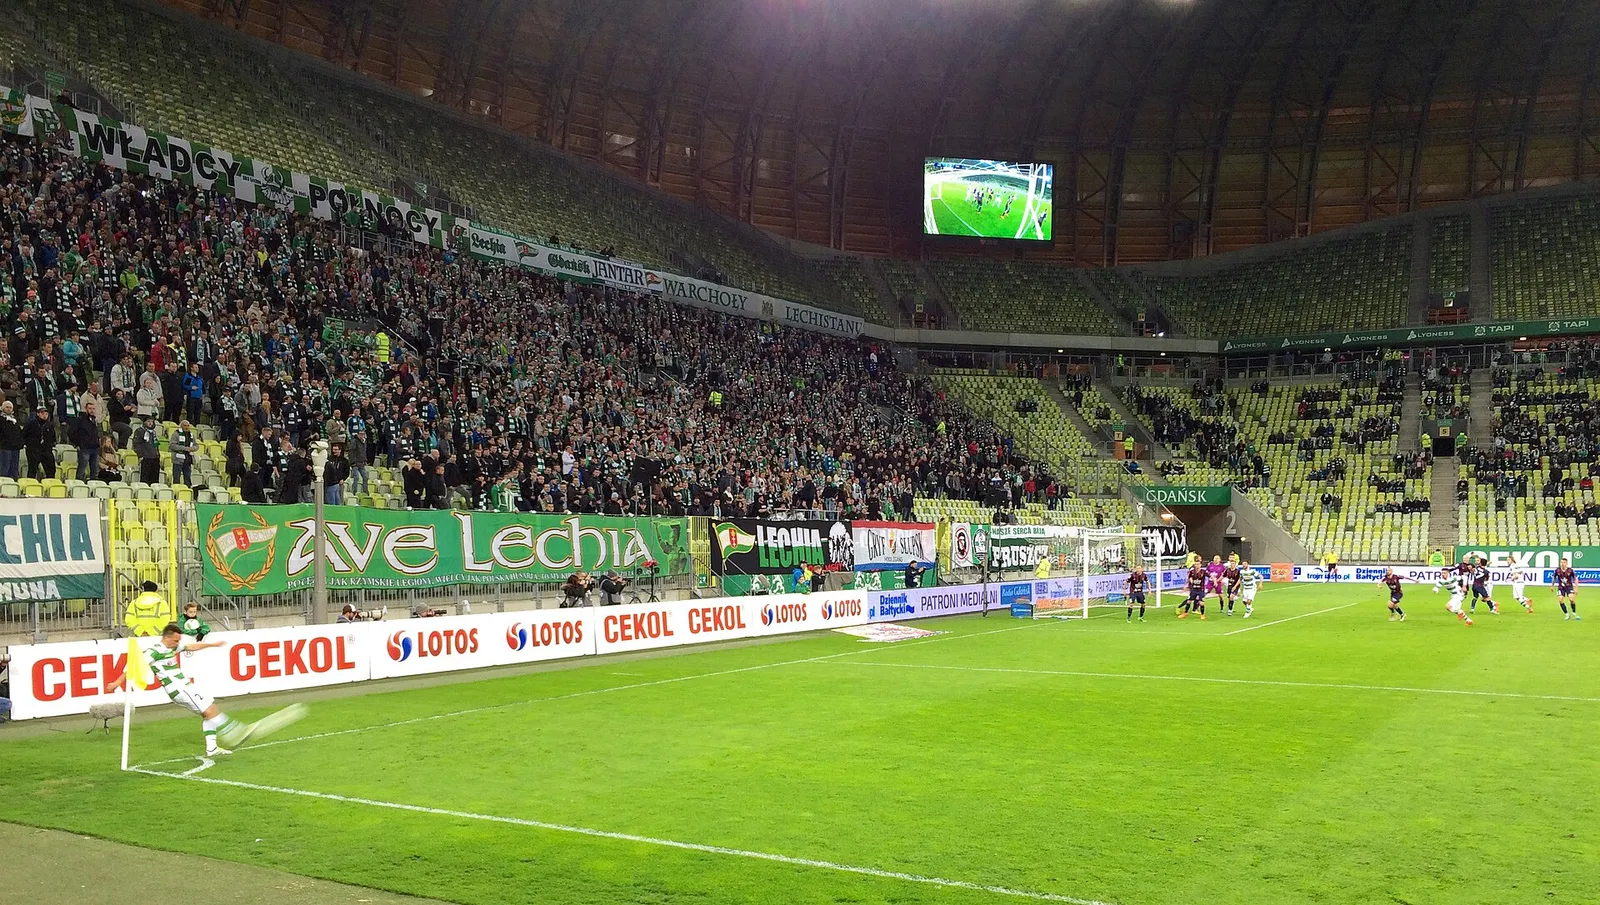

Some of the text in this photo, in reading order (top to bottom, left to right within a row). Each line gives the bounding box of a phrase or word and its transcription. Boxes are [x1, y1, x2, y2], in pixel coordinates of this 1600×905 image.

[82, 121, 241, 187] WŁADCY
[592, 260, 644, 285] JANTAR
[663, 279, 748, 310] WARCHOŁY
[1417, 330, 1454, 338] LYONESS
[1489, 325, 1514, 333] TAPI
[1563, 320, 1589, 328] TAPI
[1145, 488, 1207, 503] GDAŃSK
[1012, 527, 1032, 535] SERCA
[1226, 510, 1237, 535] 2
[756, 525, 825, 568] LECHIA
[868, 529, 885, 560] GRYF
[329, 576, 348, 586] JAK
[834, 599, 861, 618] LOTOS
[880, 593, 907, 605] Dziennik
[880, 603, 907, 617] Bałtycki
[921, 593, 958, 611] PATRONI
[688, 605, 746, 634] CEKOL
[776, 603, 807, 623] LOTOS
[531, 620, 582, 647] LOTOS
[604, 611, 674, 643] CEKOL
[417, 627, 479, 657] LOTOS
[229, 635, 356, 681] CEKOL
